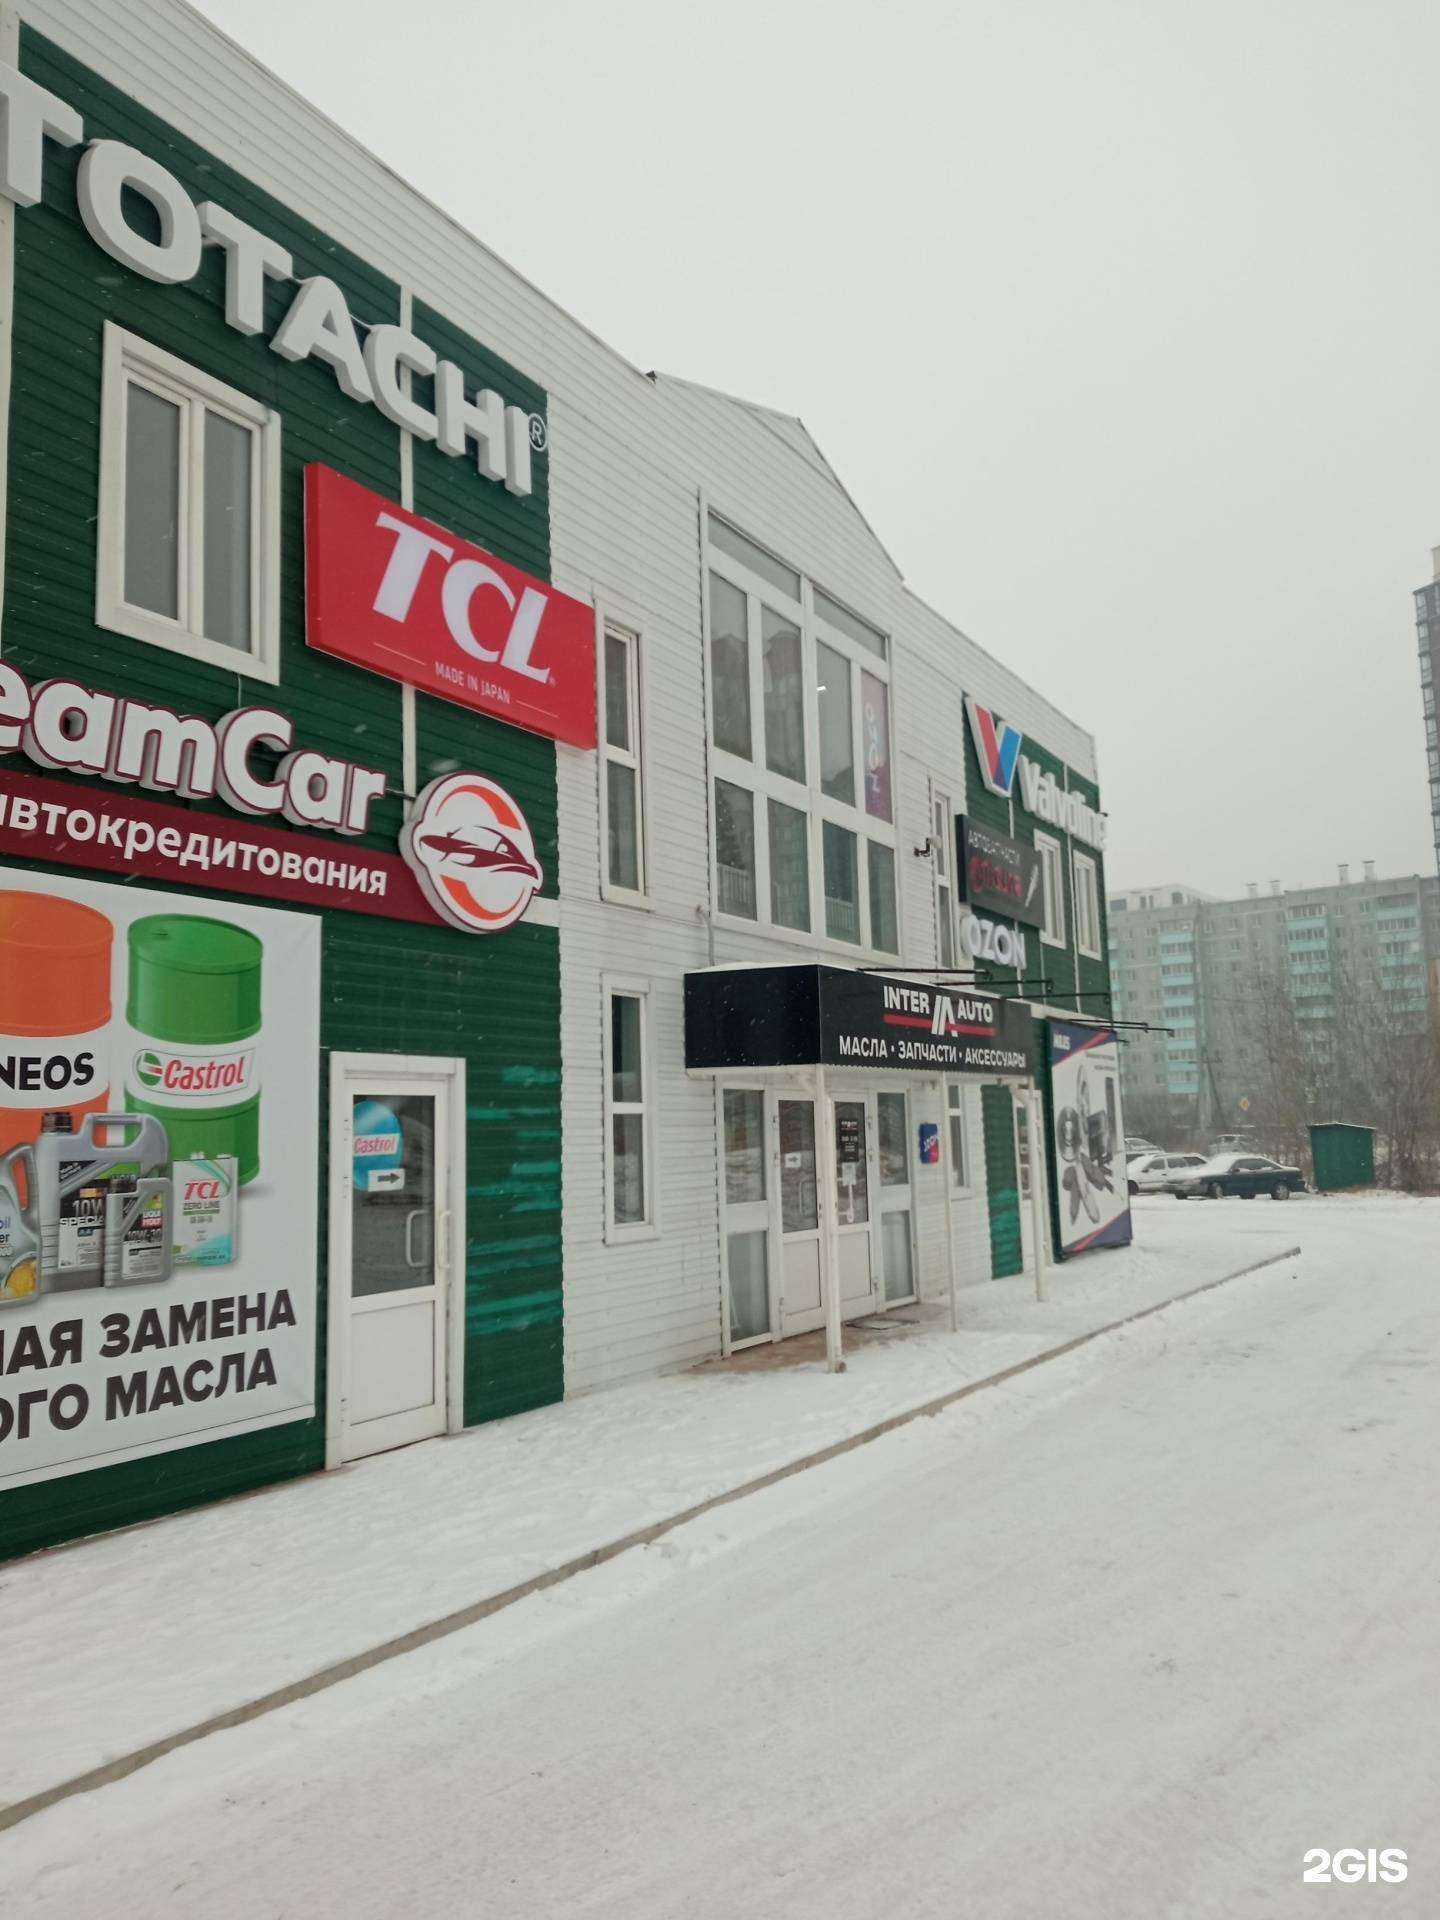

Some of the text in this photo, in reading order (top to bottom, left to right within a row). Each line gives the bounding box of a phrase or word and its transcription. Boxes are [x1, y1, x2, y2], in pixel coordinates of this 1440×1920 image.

[0, 62, 533, 496] TOTACHI
[373, 511, 551, 684] TCL
[434, 661, 512, 705] MADE IN JAPAN
[0, 794, 388, 896] втокредитования
[963, 913, 1027, 970] OZON
[883, 985, 930, 1014] INTER
[957, 998, 993, 1024] AUTO
[162, 1054, 246, 1091] Castrol
[839, 1035, 1027, 1069] МАСЛА ЗАПЧАСТИ АКСЕССУАРЫ
[184, 1180, 220, 1201] TCL
[0, 1289, 296, 1376] АЯ ЗАМЕНА
[105, 1347, 277, 1421] МАСЛА
